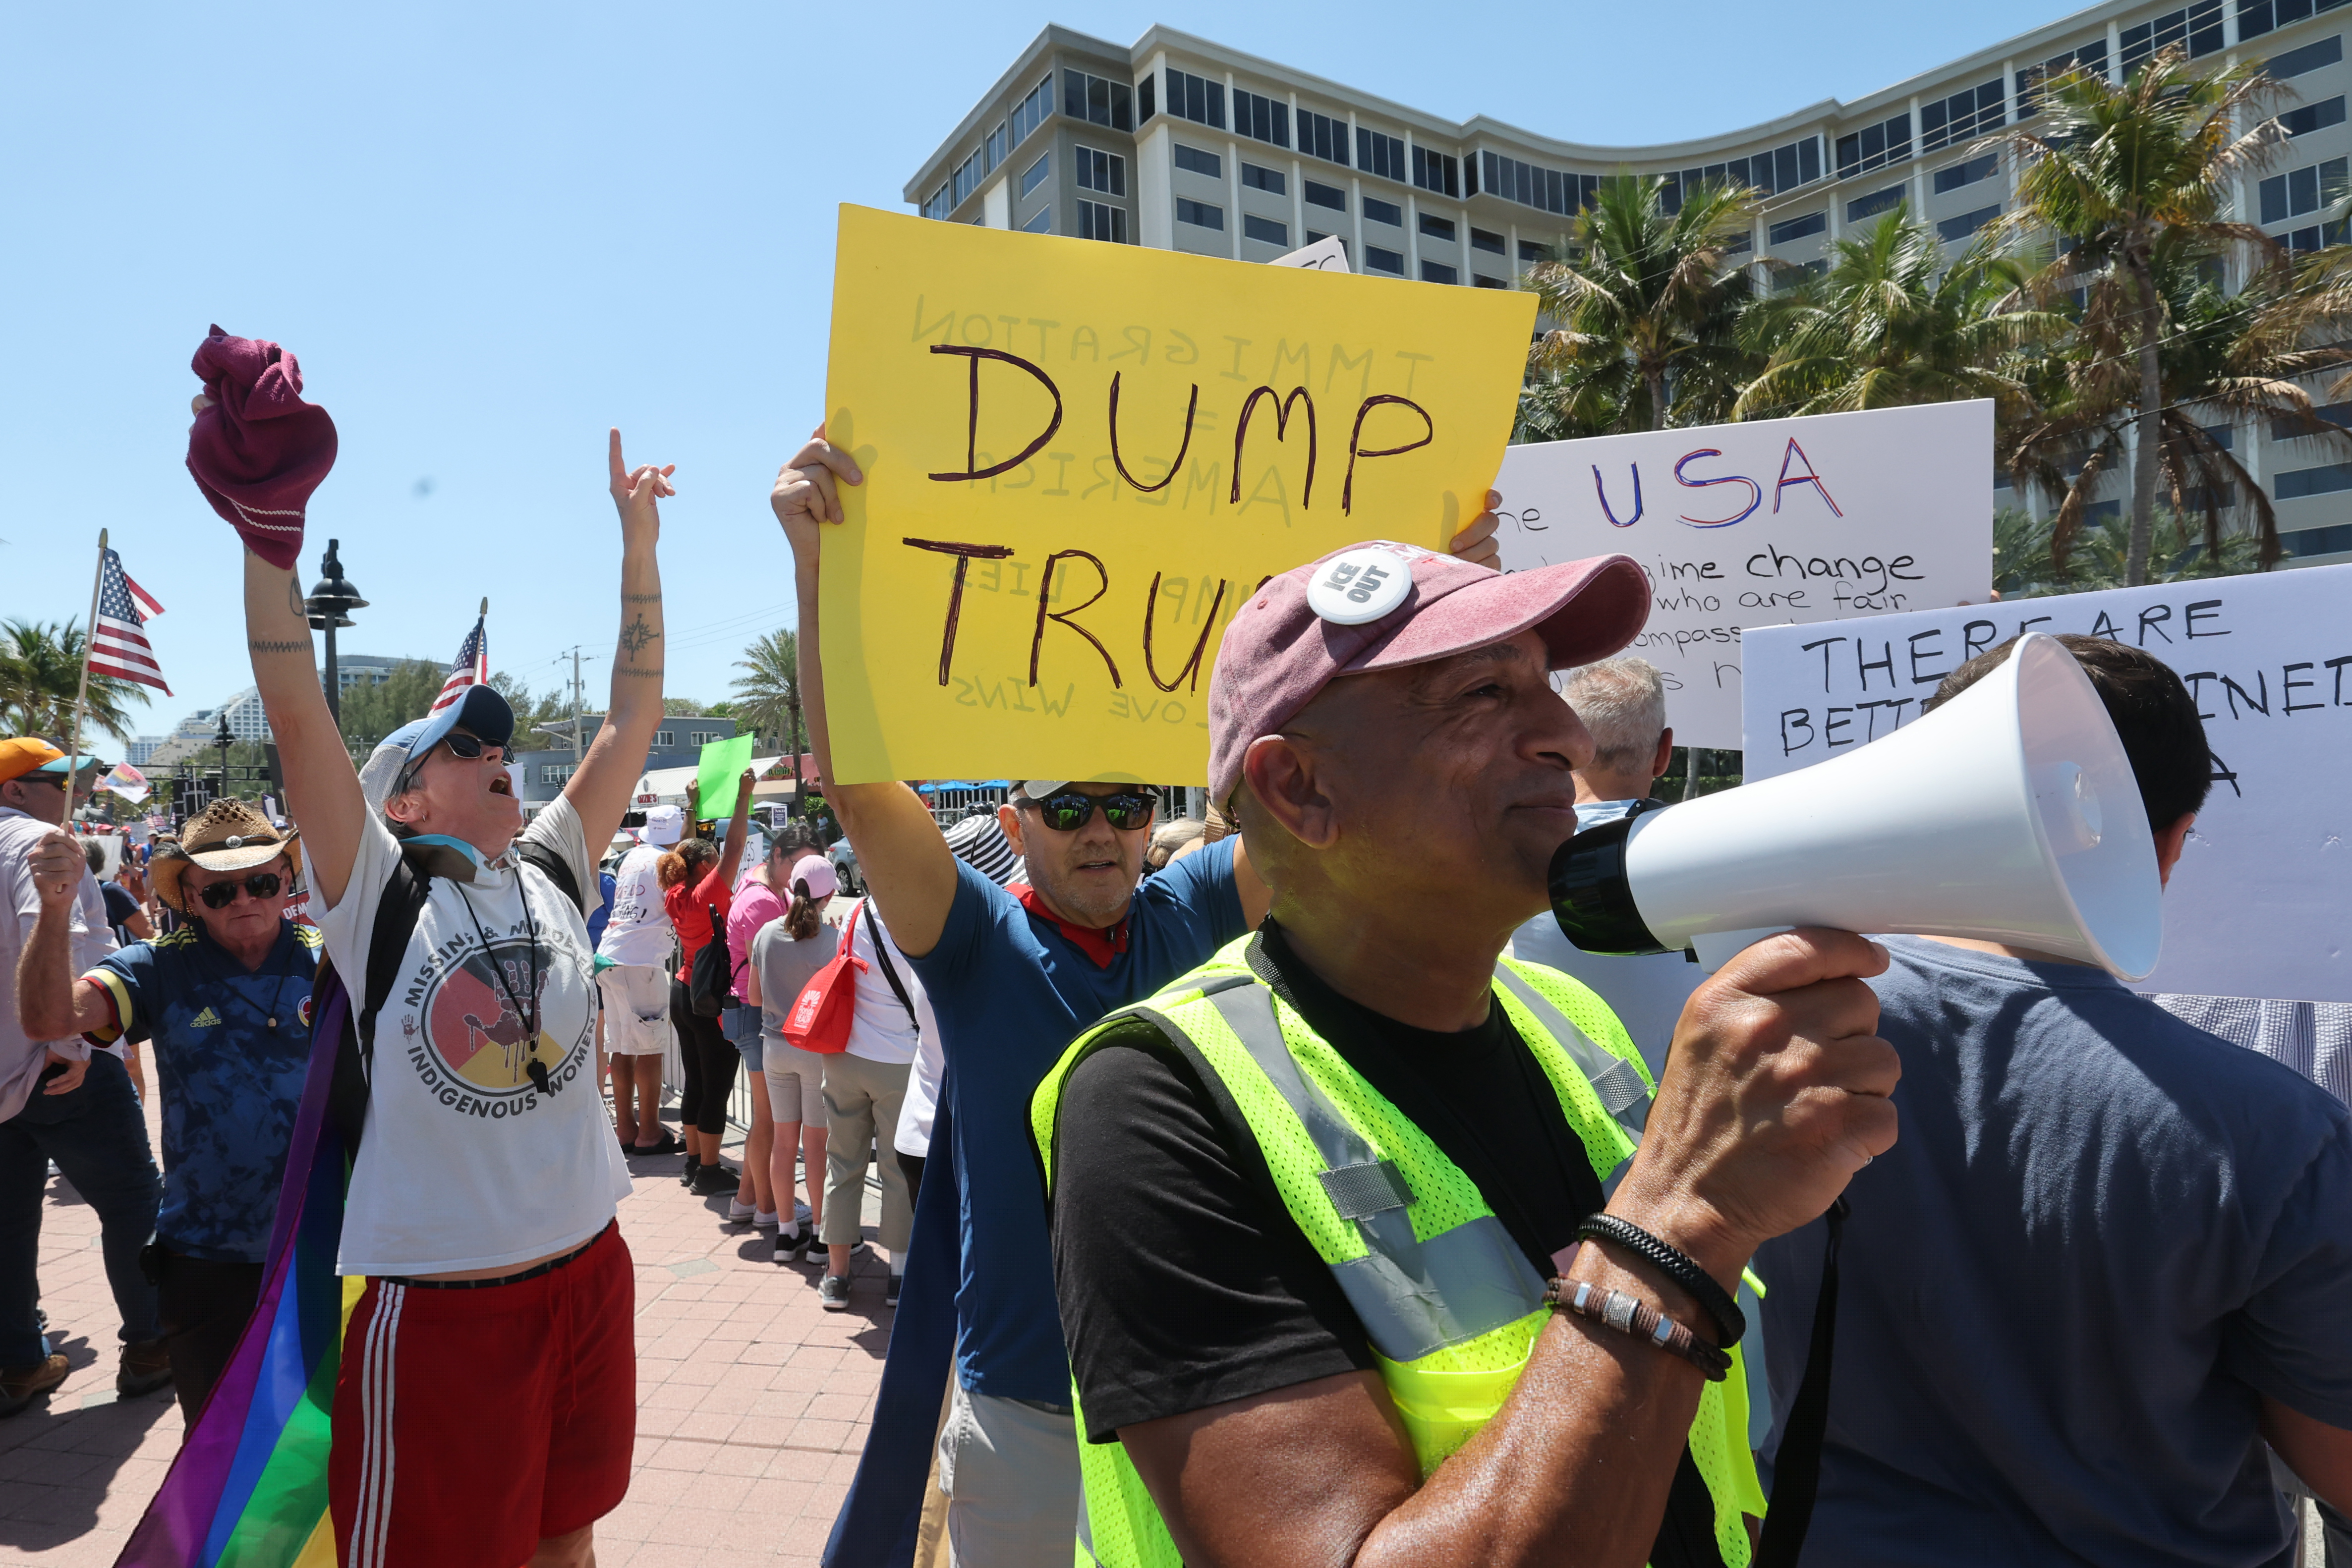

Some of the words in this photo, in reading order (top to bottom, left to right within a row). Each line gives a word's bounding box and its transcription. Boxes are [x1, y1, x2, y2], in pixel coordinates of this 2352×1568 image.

[929, 345, 1434, 516] DUMP
[1591, 437, 1844, 529] USA
[1322, 562, 1362, 592] ICE
[1347, 564, 1390, 604] OUT
[1746, 543, 1926, 595] change
[903, 537, 1274, 697] TRU
[1657, 587, 1721, 611] who
[1738, 590, 1811, 608] are
[1833, 581, 1912, 612] fair
[1626, 626, 1741, 658] ompass
[2090, 599, 2232, 647] ARE
[1781, 696, 1935, 757] BETT
[2184, 655, 2352, 720] INET
[282, 902, 308, 920] DEM
[404, 932, 474, 1008] MISSING
[484, 926, 501, 939] &
[510, 919, 594, 980] MURDEED
[190, 1018, 222, 1027] adidas
[407, 1045, 538, 1119] INDIGENOUS
[547, 1017, 596, 1099] WOMEN
